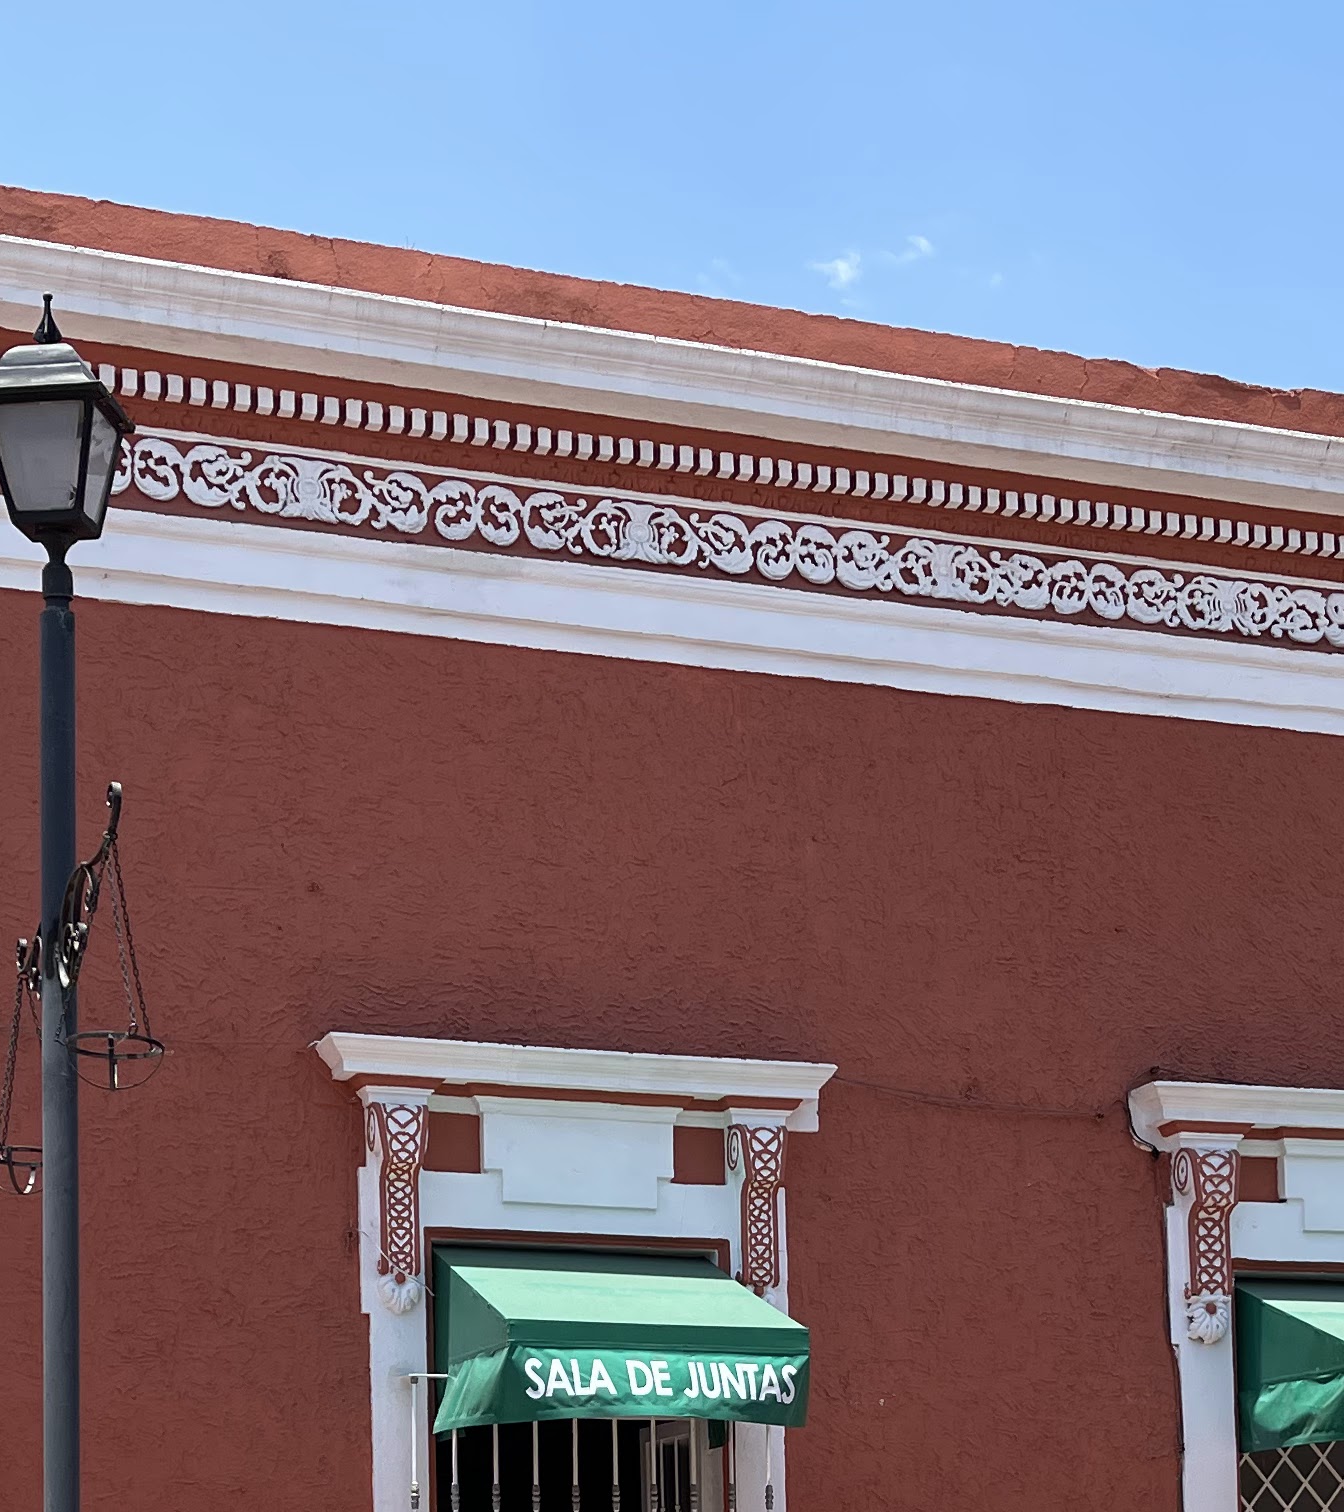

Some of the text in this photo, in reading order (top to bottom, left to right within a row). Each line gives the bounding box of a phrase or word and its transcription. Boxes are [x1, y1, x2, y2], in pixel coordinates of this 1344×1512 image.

[524, 1357, 798, 1405] SALA DE JUNTAS
